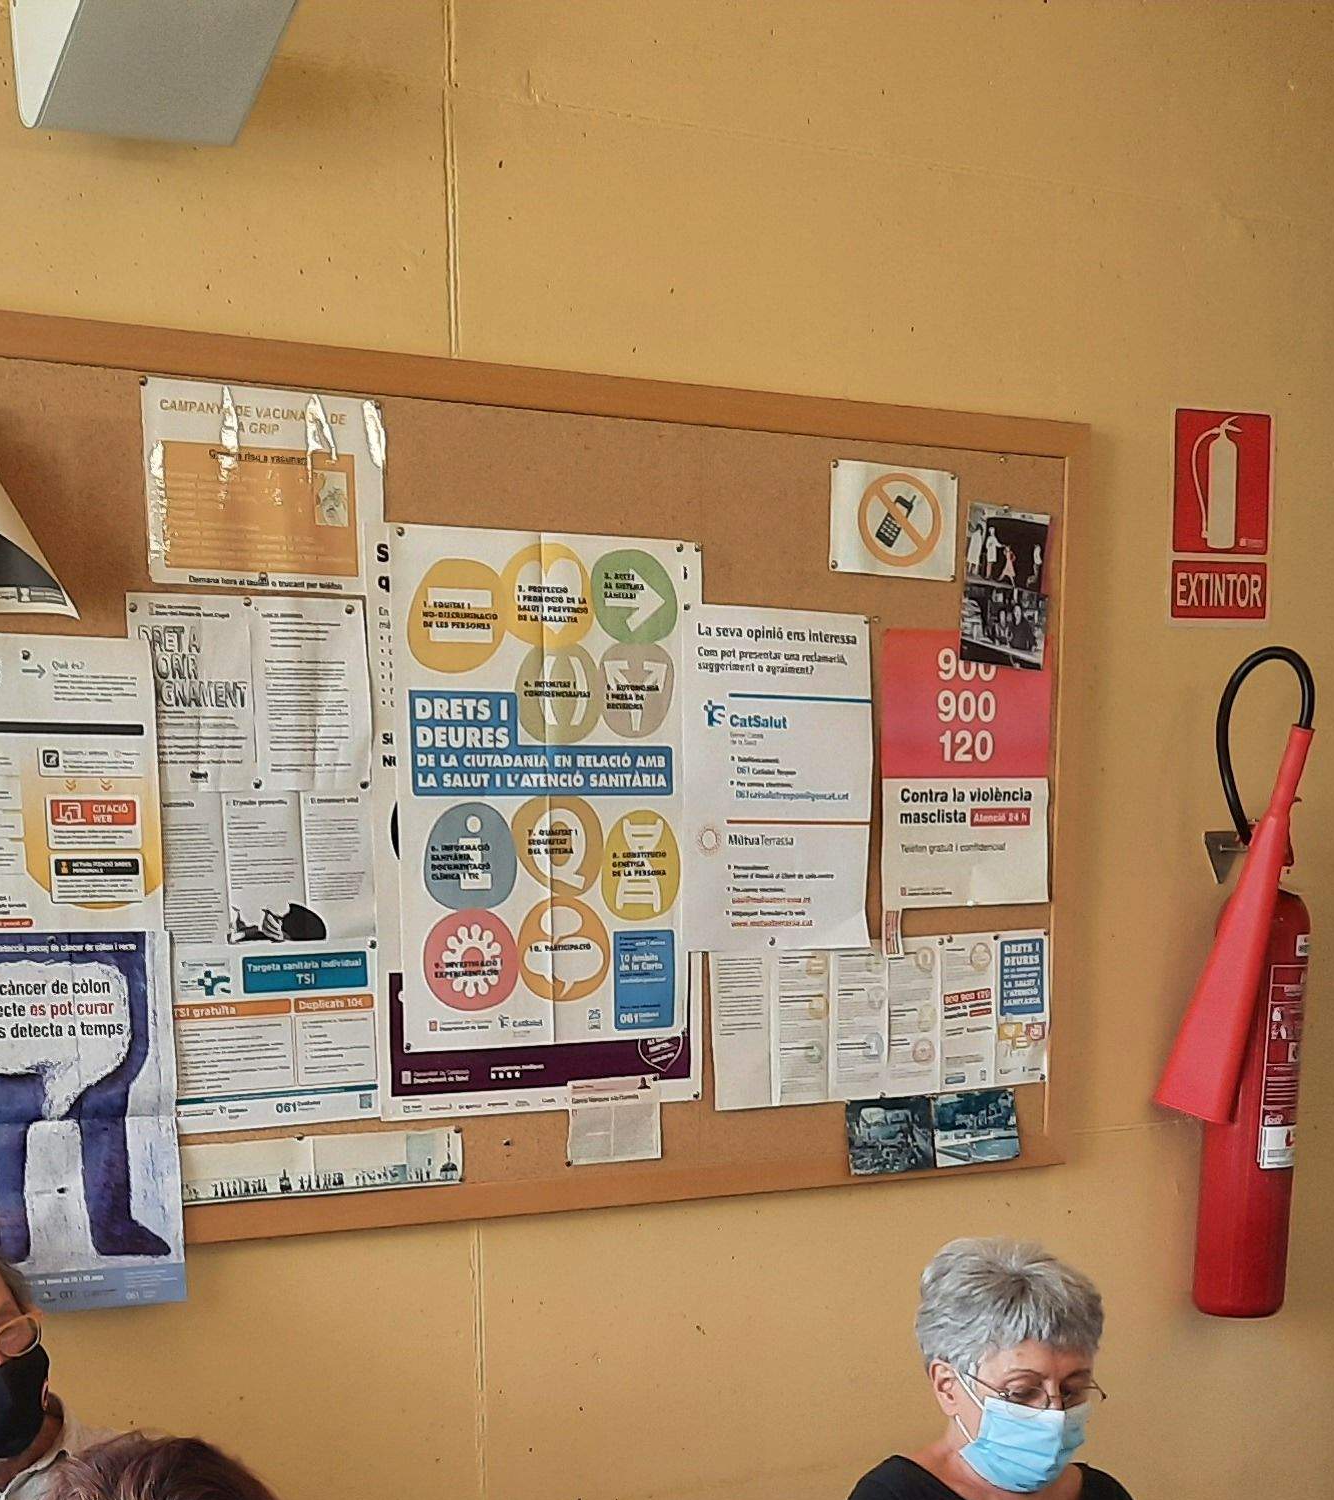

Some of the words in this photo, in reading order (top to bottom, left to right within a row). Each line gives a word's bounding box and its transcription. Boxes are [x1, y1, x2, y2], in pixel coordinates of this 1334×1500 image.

[160, 399, 231, 416] CAMPANY
[256, 407, 326, 424] VACUNA
[331, 414, 346, 425] DE
[250, 423, 279, 435] GRIP
[1177, 572, 1262, 607] EXTINTOR
[698, 623, 712, 636] La
[716, 627, 743, 638] seva
[747, 625, 783, 642] opinió
[787, 631, 806, 642] ens
[809, 630, 857, 644] interessa
[721, 649, 735, 660] pot
[160, 680, 247, 708] GNAMENT
[415, 698, 491, 721] DRETS
[500, 698, 509, 721] I
[937, 689, 996, 723] 900
[730, 714, 787, 729] CatSalut
[415, 726, 510, 748] DEURES
[939, 729, 995, 763] 120
[417, 754, 436, 767] DE
[441, 754, 458, 767] LA
[463, 754, 547, 768] CIUTADANIA
[554, 754, 572, 767] EN
[576, 752, 631, 768] RELACIÓ
[635, 754, 666, 767] AMB
[417, 774, 437, 788] LA
[443, 774, 490, 788] SALUT
[496, 774, 500, 788] I
[507, 771, 584, 788] L'ATENCIÓ
[589, 771, 667, 788] SANITÀRIA
[901, 788, 948, 803] Contra
[953, 788, 965, 802] la
[970, 787, 1032, 802] violència
[93, 803, 128, 813] CITACIÓ
[900, 809, 966, 824] masclista
[973, 811, 1006, 823] Atenció
[1022, 811, 1027, 822] h
[248, 962, 281, 973] Targeta
[0, 980, 46, 996] càncer
[52, 980, 68, 995] de
[73, 978, 110, 994] còlon
[296, 973, 316, 984] TSI
[30, 1005, 46, 1016] es
[50, 1001, 73, 1019] pot
[77, 1002, 114, 1015] curar
[11, 1024, 63, 1038] detecta
[68, 1025, 76, 1036] a
[81, 1022, 124, 1038] temps
